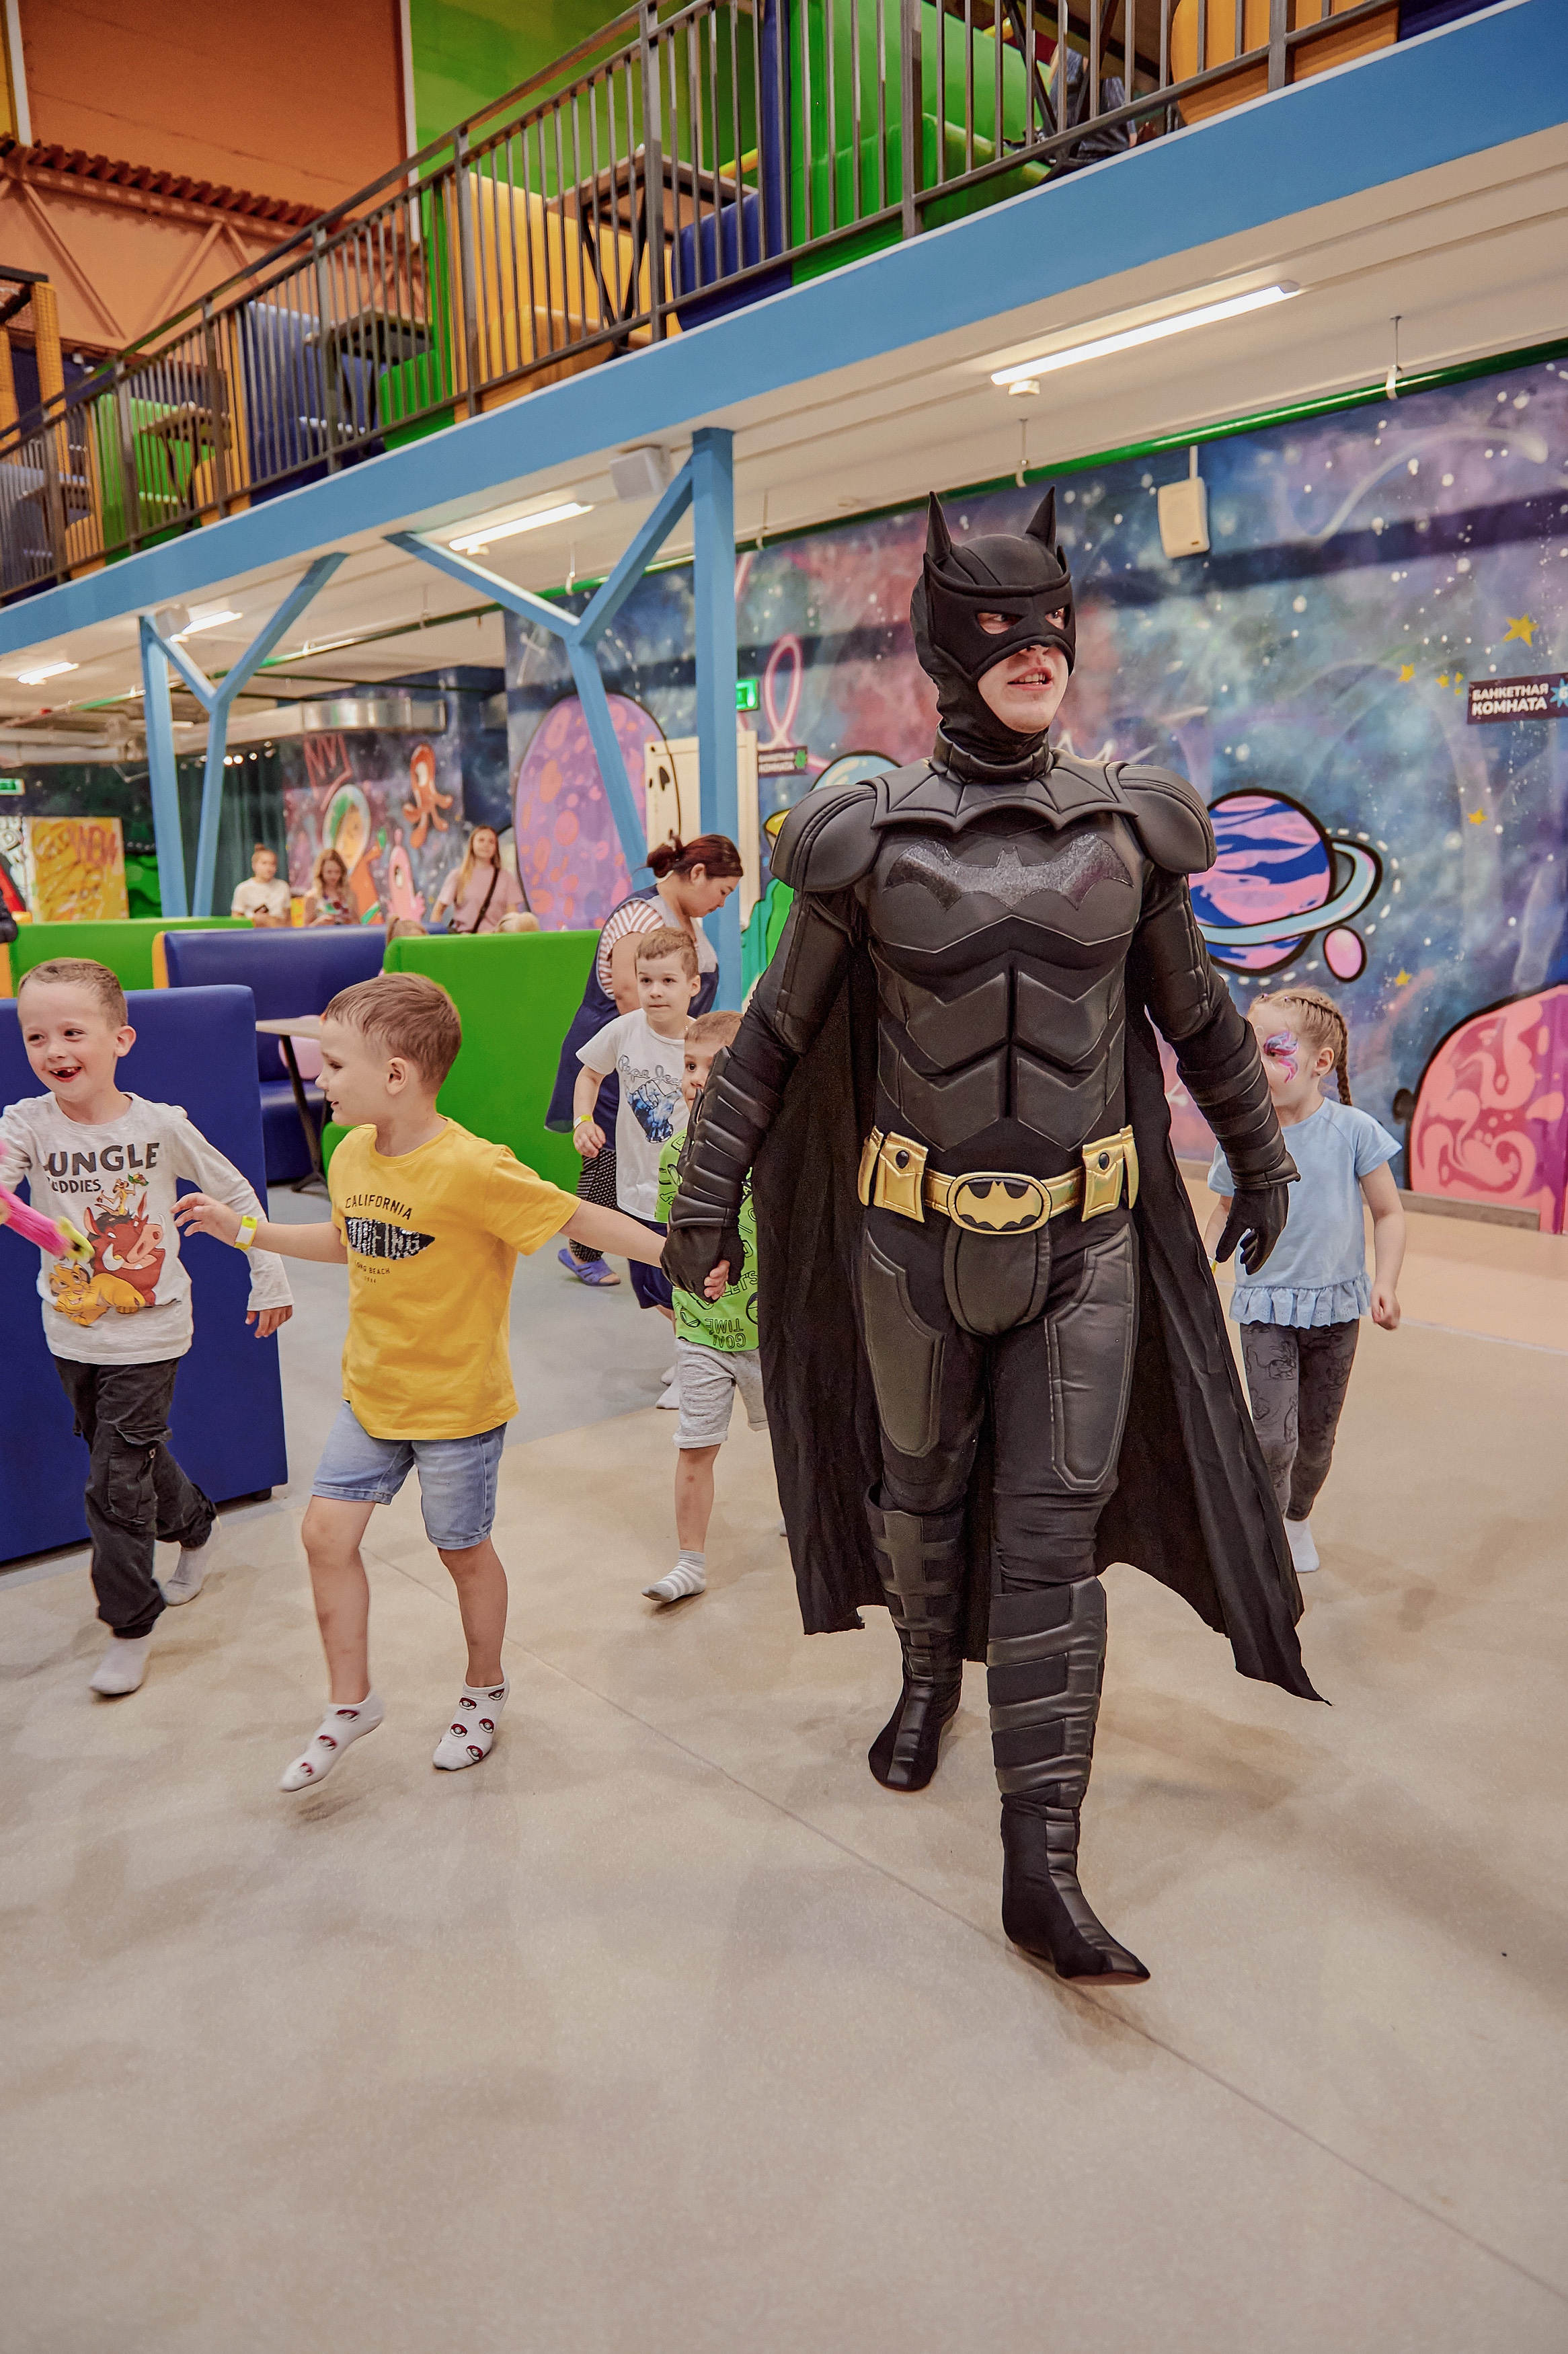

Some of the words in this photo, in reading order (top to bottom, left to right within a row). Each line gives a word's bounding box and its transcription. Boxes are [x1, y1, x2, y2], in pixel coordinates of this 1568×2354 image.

[1472, 682, 1549, 701] БАНКЕТНАЯ
[1471, 696, 1548, 716] КОМНАТА
[43, 1143, 160, 1177] UNGLE
[46, 1176, 102, 1194] UDDIES
[345, 1194, 412, 1221] CALIFORNIA
[705, 1318, 744, 1333] TIME
